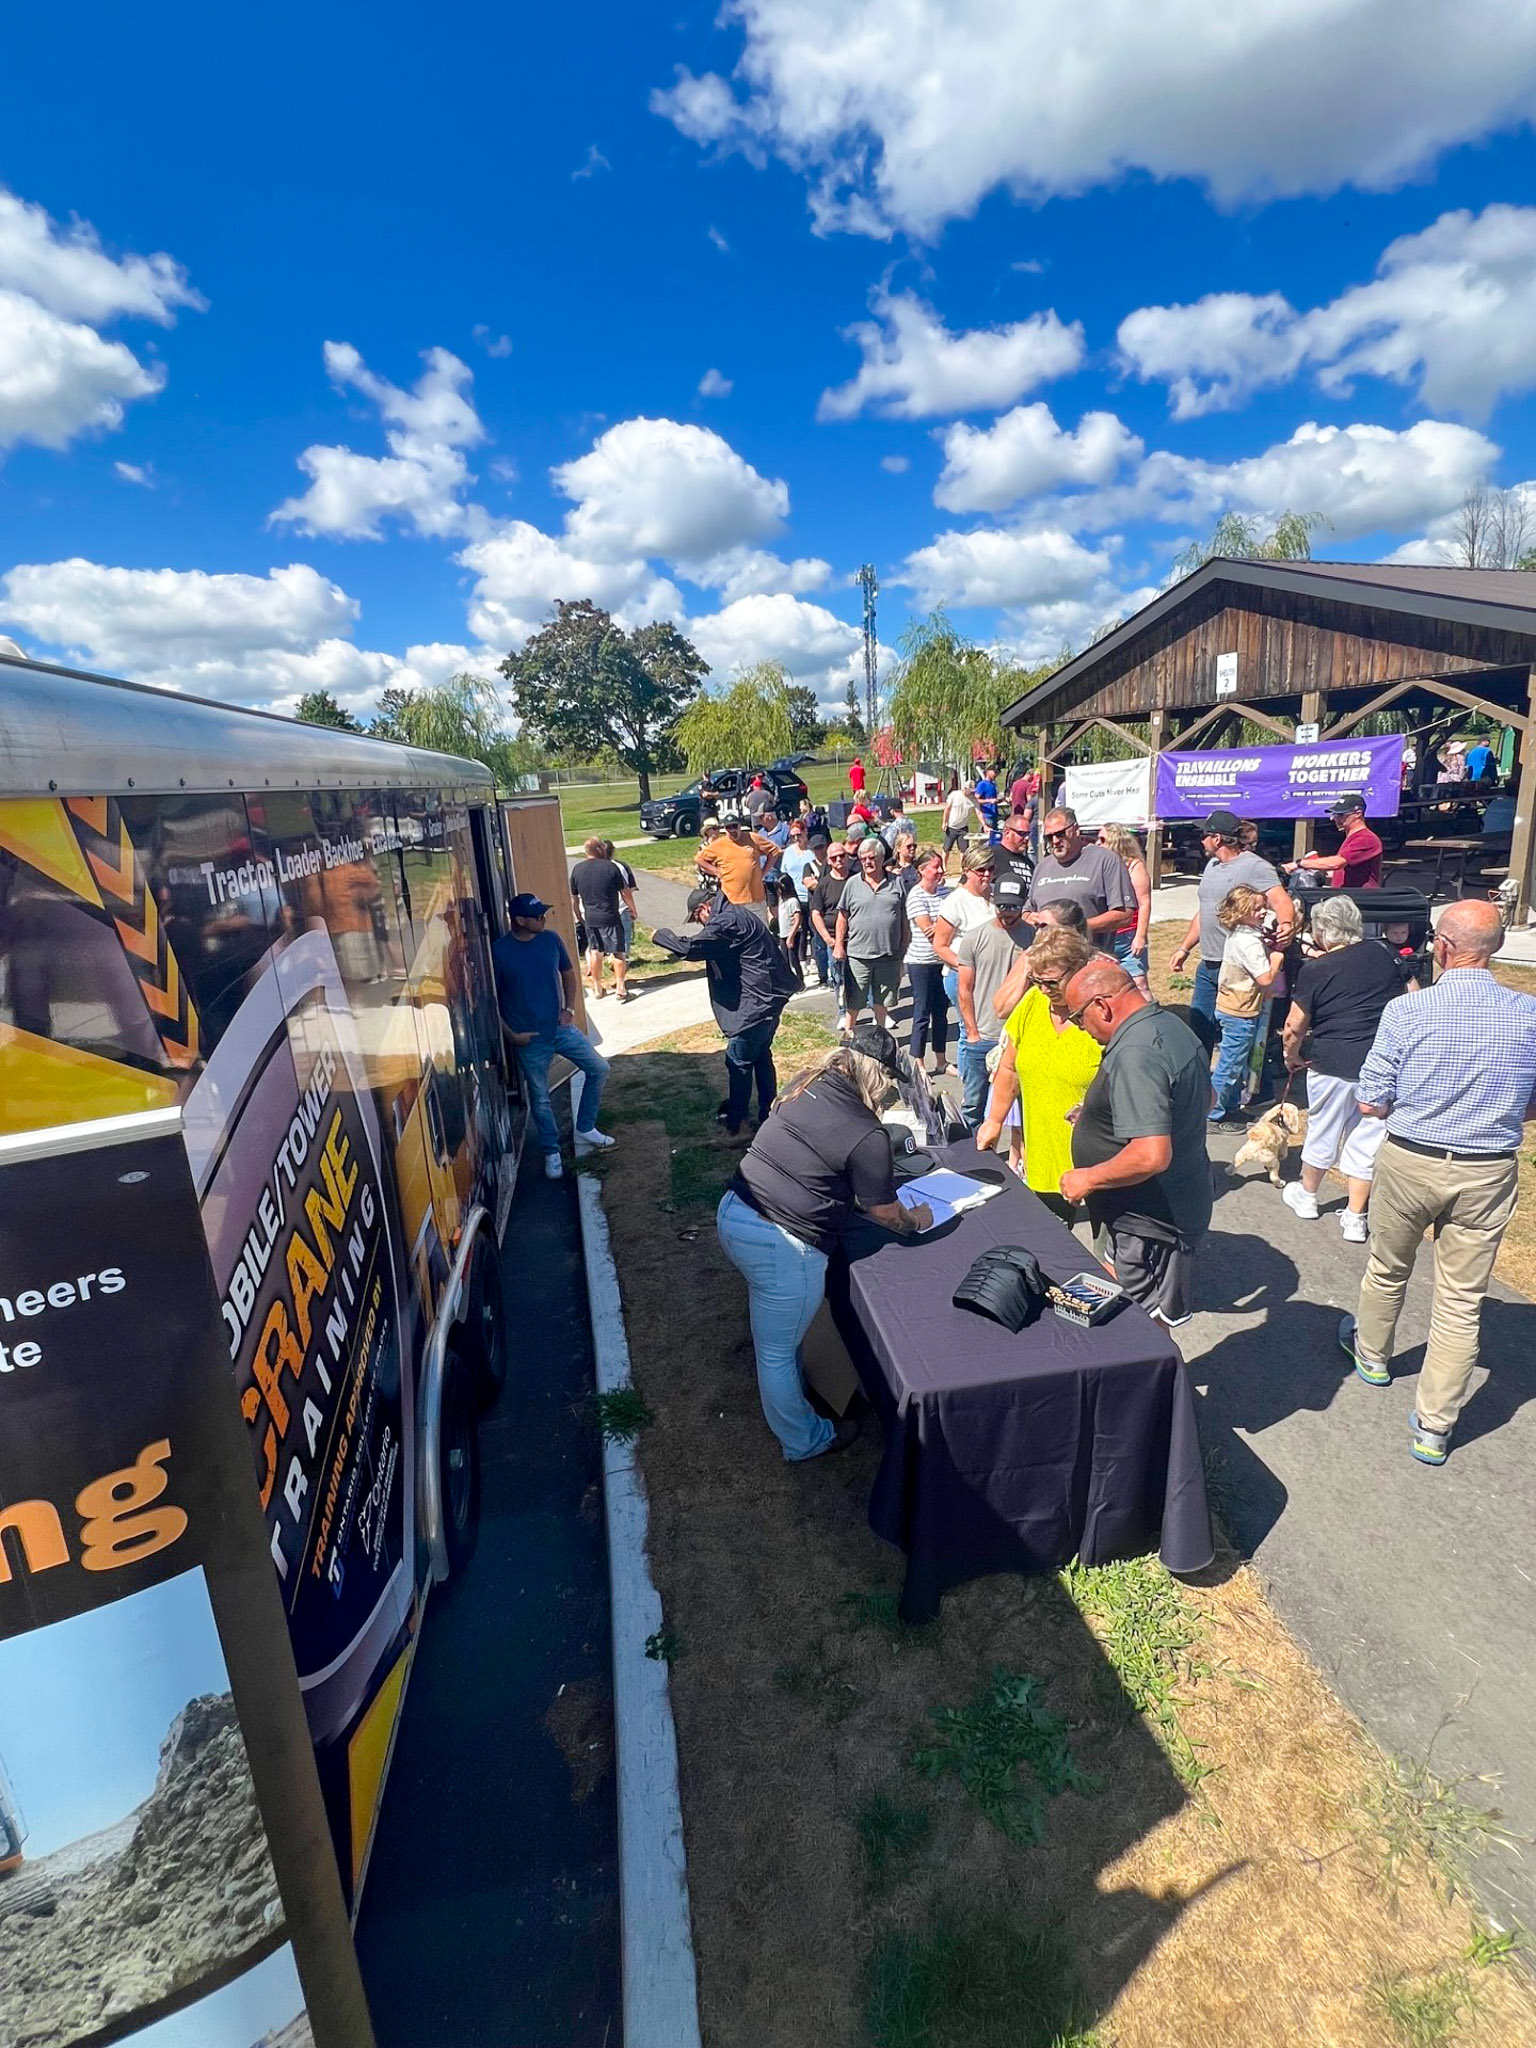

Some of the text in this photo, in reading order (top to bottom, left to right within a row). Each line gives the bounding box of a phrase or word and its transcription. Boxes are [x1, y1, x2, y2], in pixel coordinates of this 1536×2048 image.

[1224, 678, 1230, 688] 2
[1176, 758, 1261, 774] TRAVAILLONS
[1291, 751, 1372, 769] WORKERS
[1175, 772, 1236, 787] ENSEMBLE
[1288, 767, 1371, 784] TOGETHER
[1090, 789, 1105, 798] Cuts
[1106, 787, 1125, 796] Nver
[200, 860, 274, 905] Tractor
[275, 842, 322, 883] Loader
[323, 835, 365, 869] Backhoe
[1037, 874, 1091, 887] Champion
[221, 1040, 336, 1360] BILE/TOWER
[241, 1106, 358, 1513] CRANE
[311, 1433, 348, 1579] TRAINING
[345, 1308, 376, 1437] APPROVED
[372, 1425, 391, 1506] Ontario
[337, 1467, 357, 1545] ONTARIO
